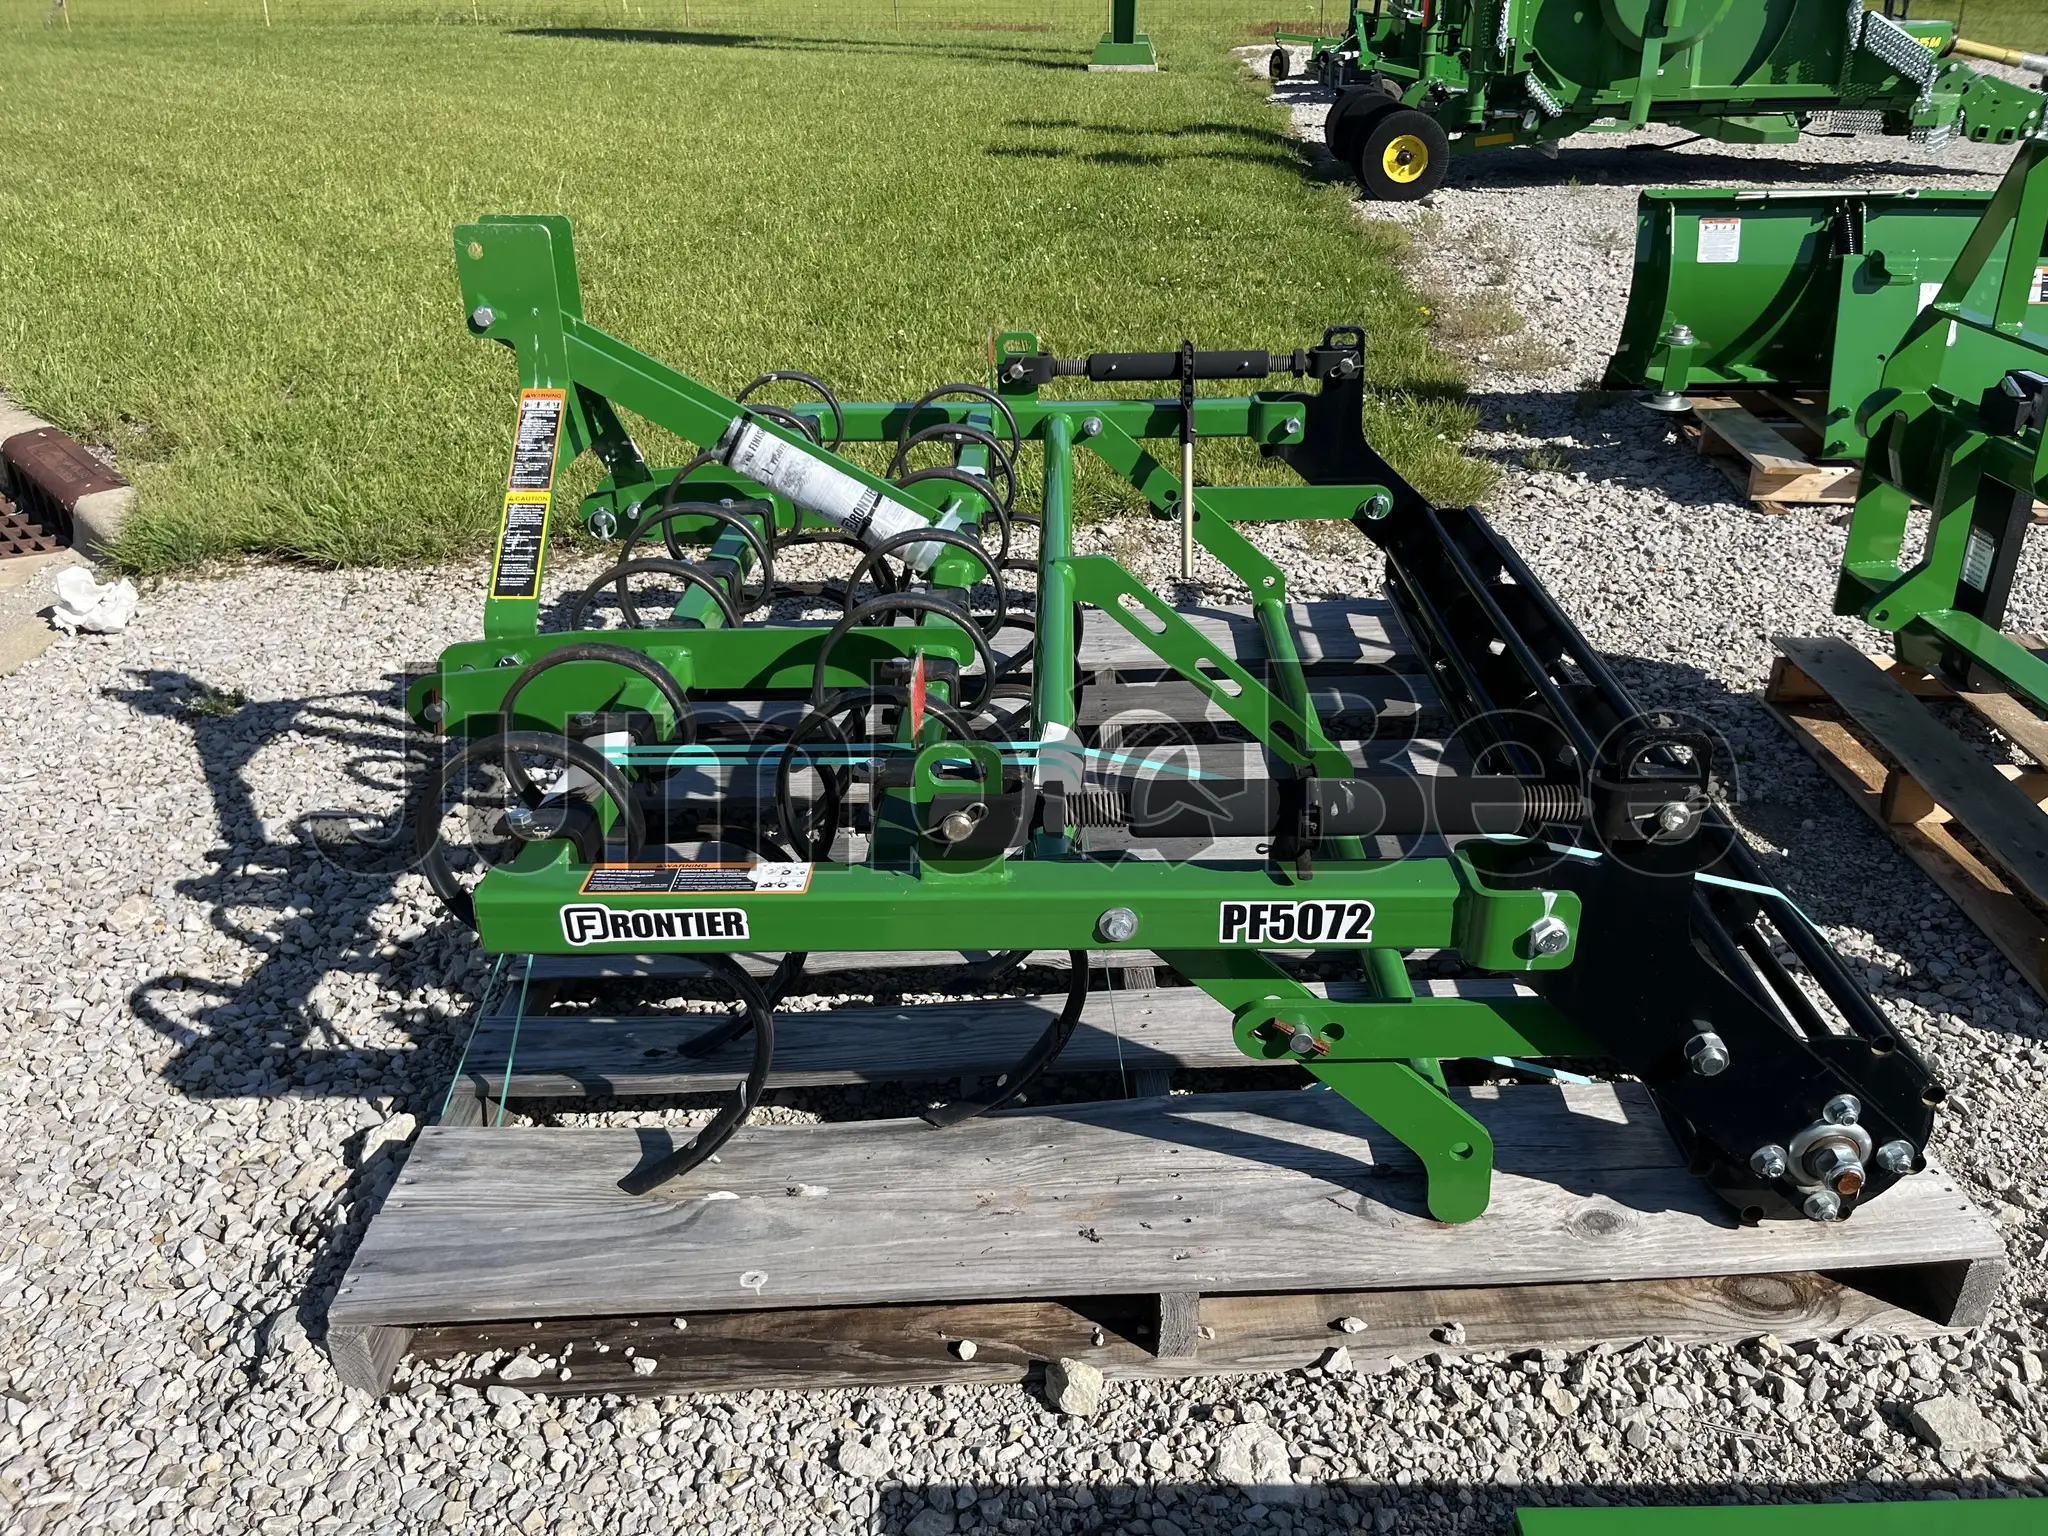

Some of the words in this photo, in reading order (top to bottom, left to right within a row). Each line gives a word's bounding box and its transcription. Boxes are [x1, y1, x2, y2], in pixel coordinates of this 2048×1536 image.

[841, 487, 879, 533] FRONTIE
[564, 907, 745, 943] FRONTIER
[1222, 903, 1372, 940] PF5072
